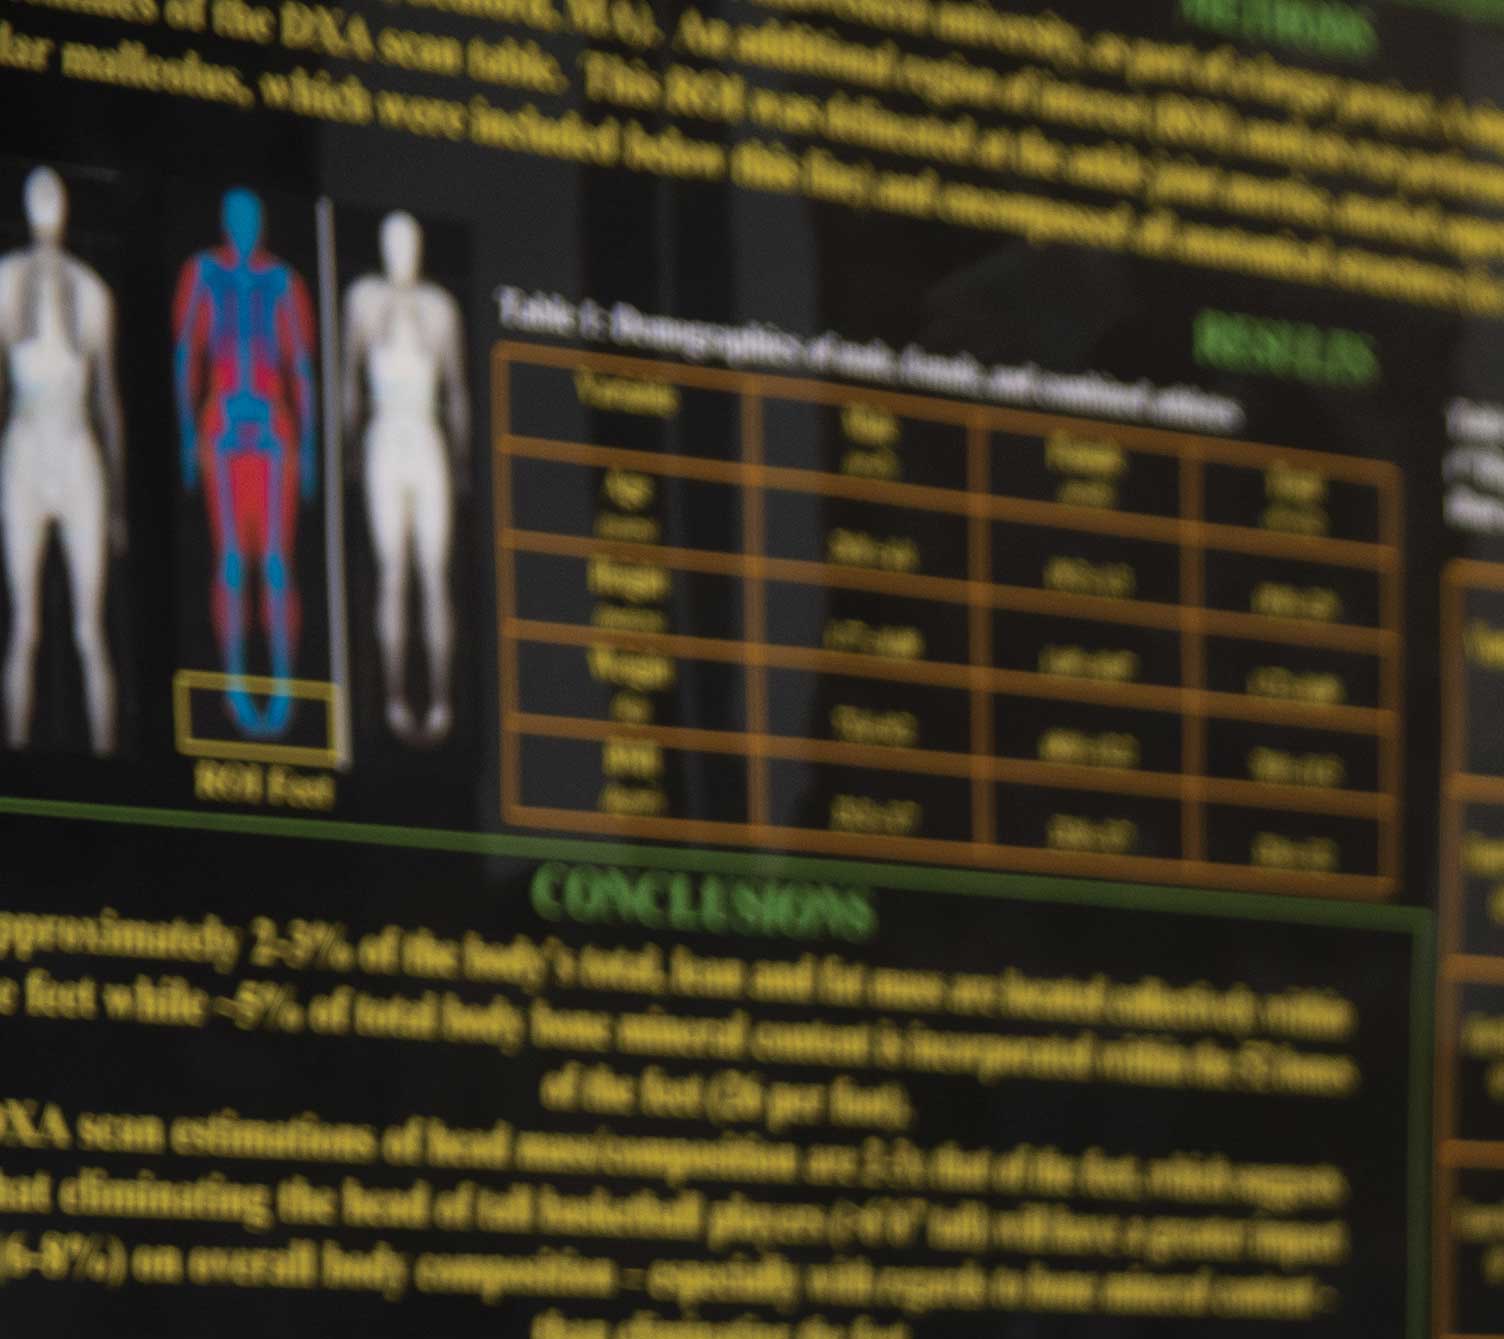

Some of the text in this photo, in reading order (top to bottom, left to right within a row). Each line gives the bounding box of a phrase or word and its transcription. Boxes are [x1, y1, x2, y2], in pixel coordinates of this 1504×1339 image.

[530, 862, 879, 941] CONCLUSIONS
[0, 910, 240, 971] pproximately
[0, 1172, 51, 1212] hat
